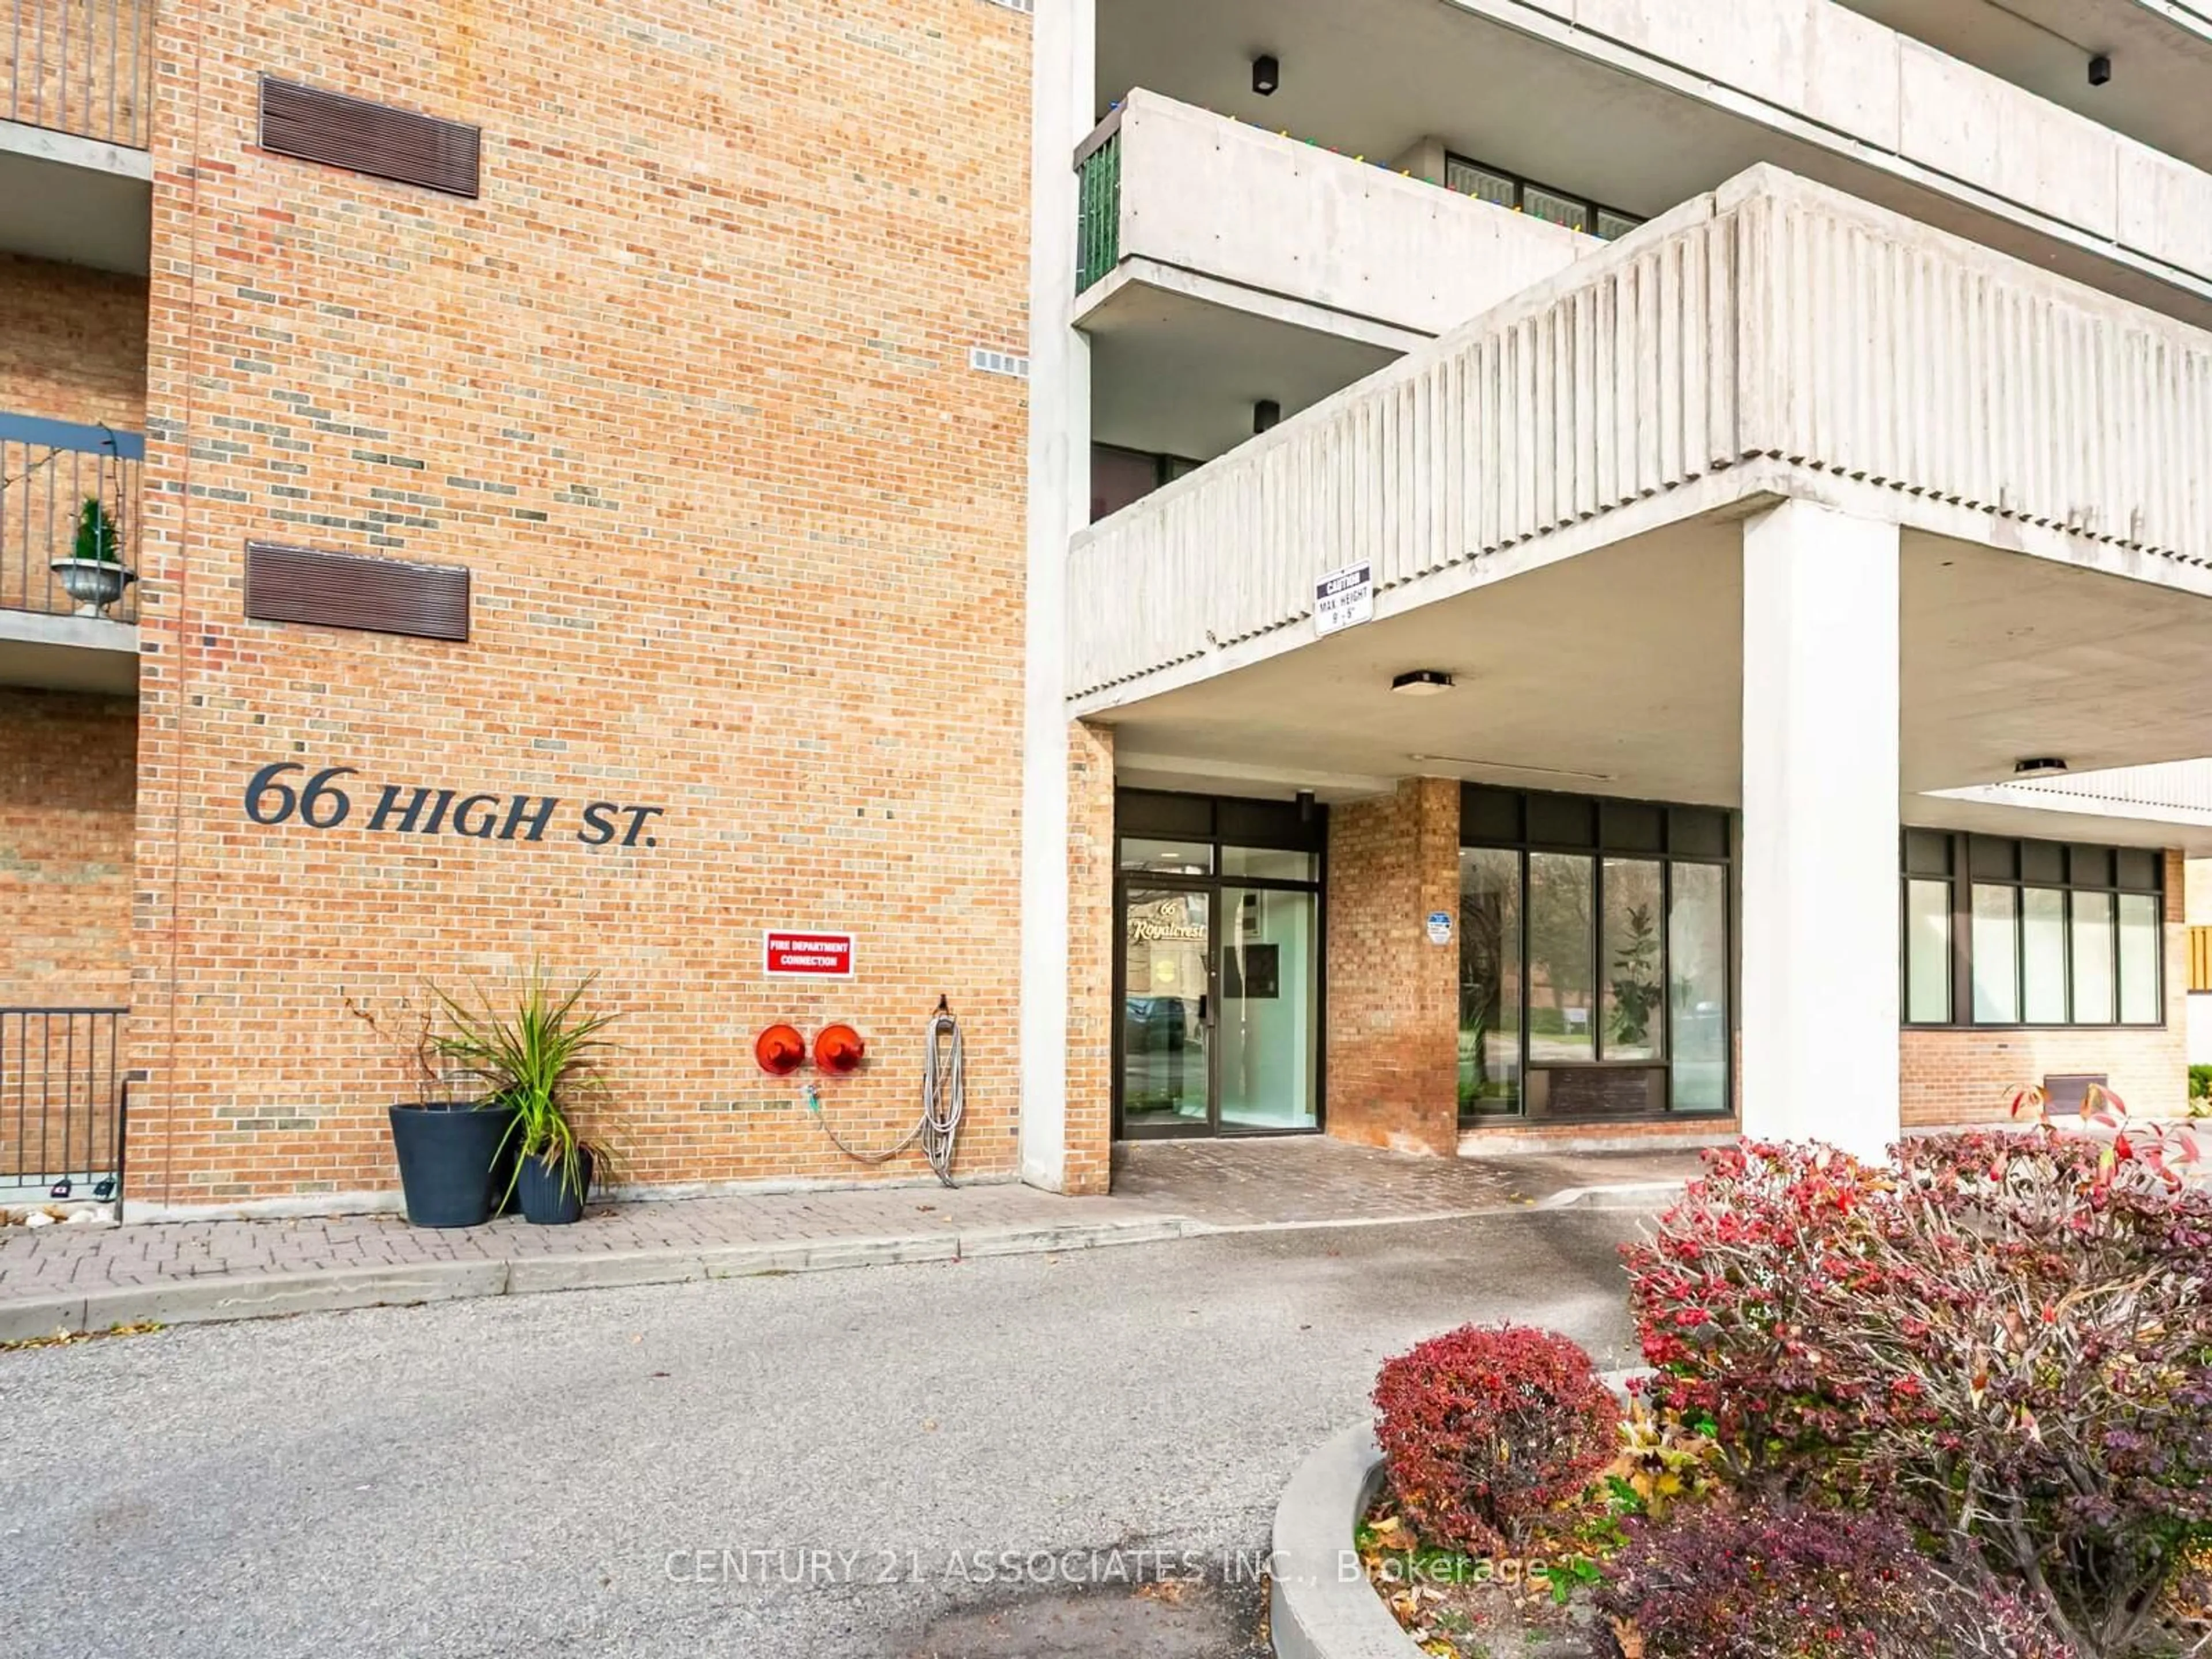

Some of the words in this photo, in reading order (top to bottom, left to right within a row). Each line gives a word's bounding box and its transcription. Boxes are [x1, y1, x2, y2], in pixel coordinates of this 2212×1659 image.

[1327, 571, 1360, 596] CAUTION
[1340, 586, 1367, 607] HEIGHT
[245, 762, 358, 828] 66
[366, 785, 560, 841] HIGH
[577, 802, 664, 847] ST.
[1161, 902, 1177, 915] 66
[1134, 921, 1205, 941] Royalcrest
[770, 940, 790, 950] FIRE
[792, 941, 849, 952] DEPARTMENT
[781, 955, 838, 967] CONNECTION
